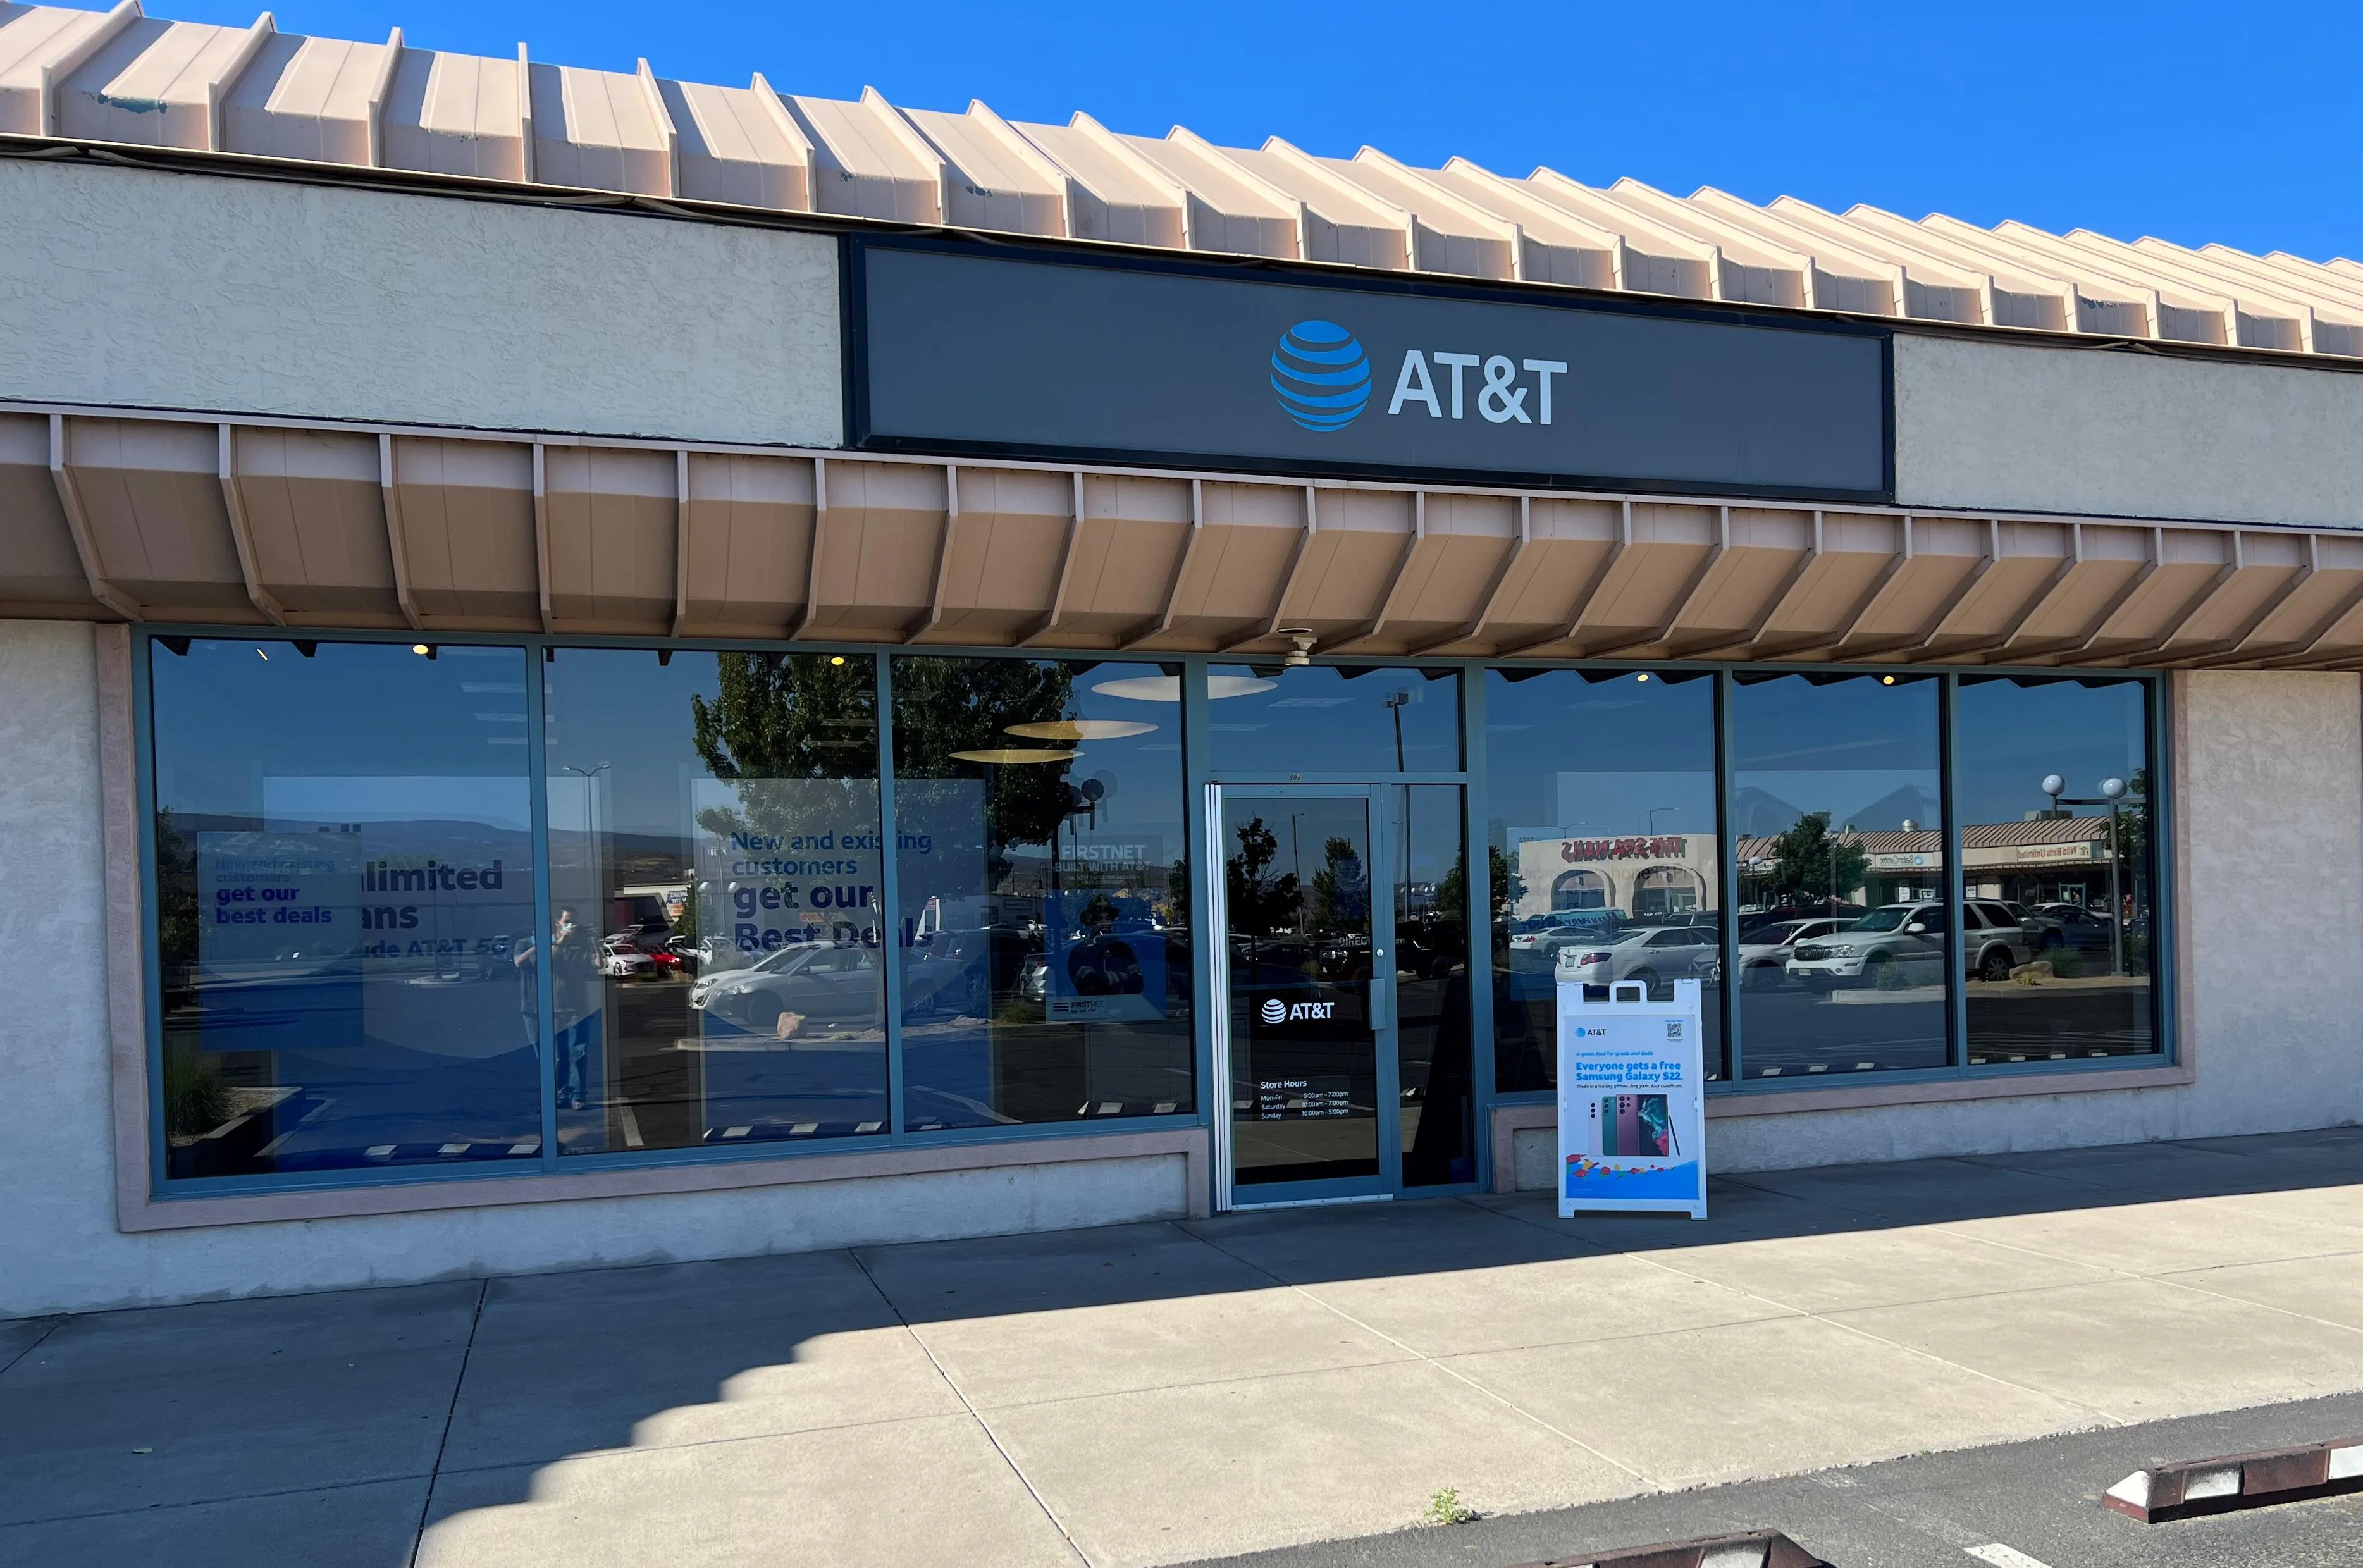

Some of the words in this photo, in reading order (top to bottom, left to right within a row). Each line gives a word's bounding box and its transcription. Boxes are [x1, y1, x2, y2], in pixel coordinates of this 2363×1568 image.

[1388, 349, 1568, 425] AT&T
[732, 832, 784, 851] New
[791, 830, 834, 850] and
[841, 830, 932, 854] exising
[1061, 844, 1145, 859] FIRSTNET
[216, 859, 245, 869] New
[254, 858, 276, 869] and
[280, 858, 336, 872] existing
[732, 858, 858, 876] customers
[1055, 862, 1084, 872] BUILT
[1089, 861, 1118, 872] WITH
[1121, 861, 1151, 871] AT&T
[216, 874, 290, 883] customers
[216, 886, 256, 906] get
[261, 887, 300, 901] our
[734, 882, 799, 918] get
[810, 886, 874, 908] our
[216, 906, 267, 924] best
[273, 906, 332, 923] deals
[734, 923, 821, 951] Best
[407, 939, 467, 957] AT&T
[1289, 1002, 1335, 1020] AT&T
[1576, 1062, 1624, 1072] Everyone
[1626, 1061, 1649, 1071] gets
[1659, 1061, 1681, 1070] free
[1576, 1073, 1623, 1082] Samsung
[1626, 1071, 1660, 1082] Galaxy
[1663, 1072, 1684, 1080] S22.
